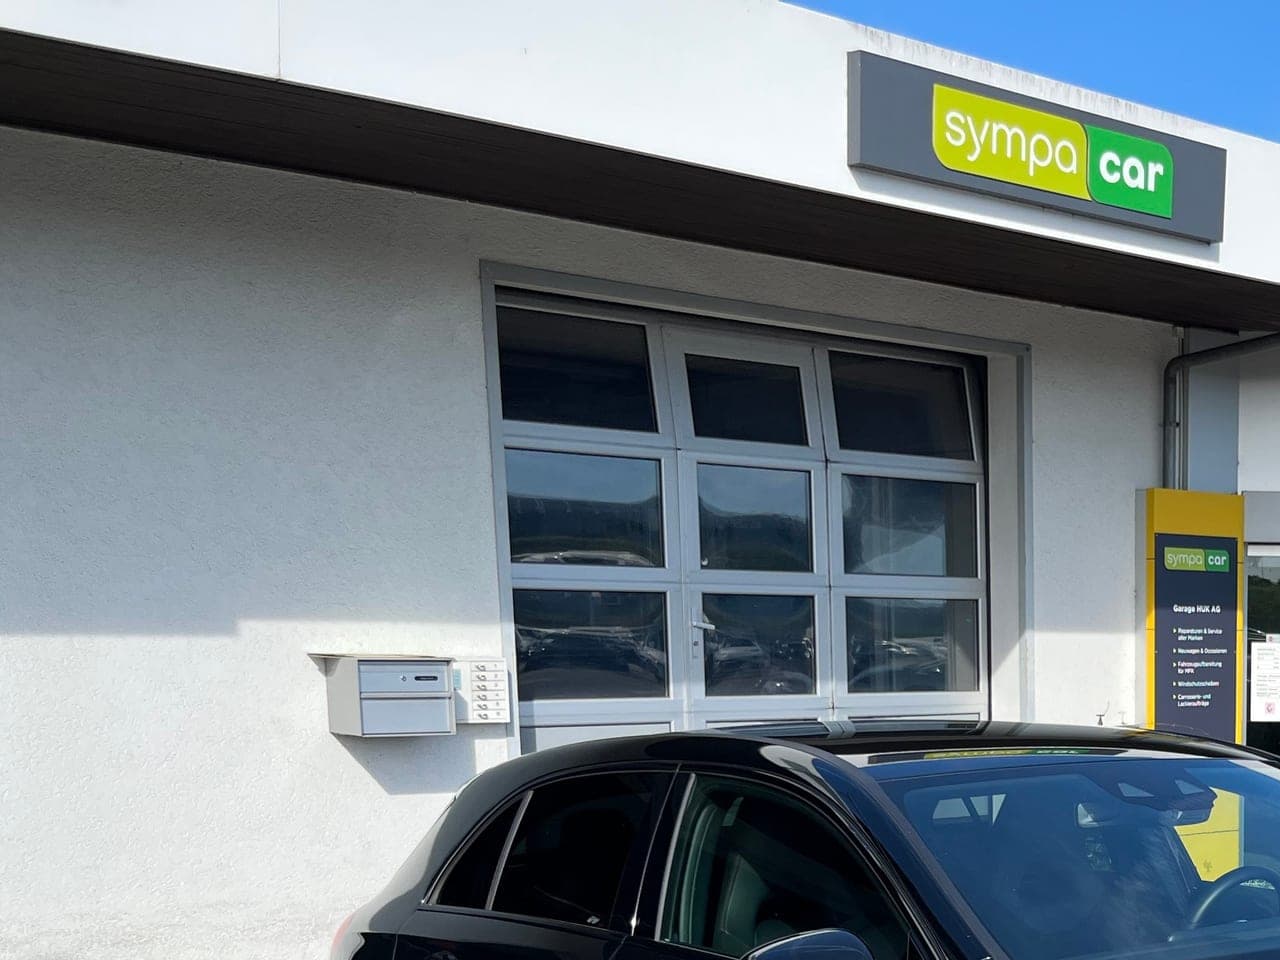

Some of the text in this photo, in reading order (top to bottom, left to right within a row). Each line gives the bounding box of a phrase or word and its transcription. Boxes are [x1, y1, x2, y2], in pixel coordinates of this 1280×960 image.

[945, 111, 1164, 192] sympa car
[1167, 553, 1227, 568] sympa car
[1173, 604, 1221, 614] Garage HUK AG
